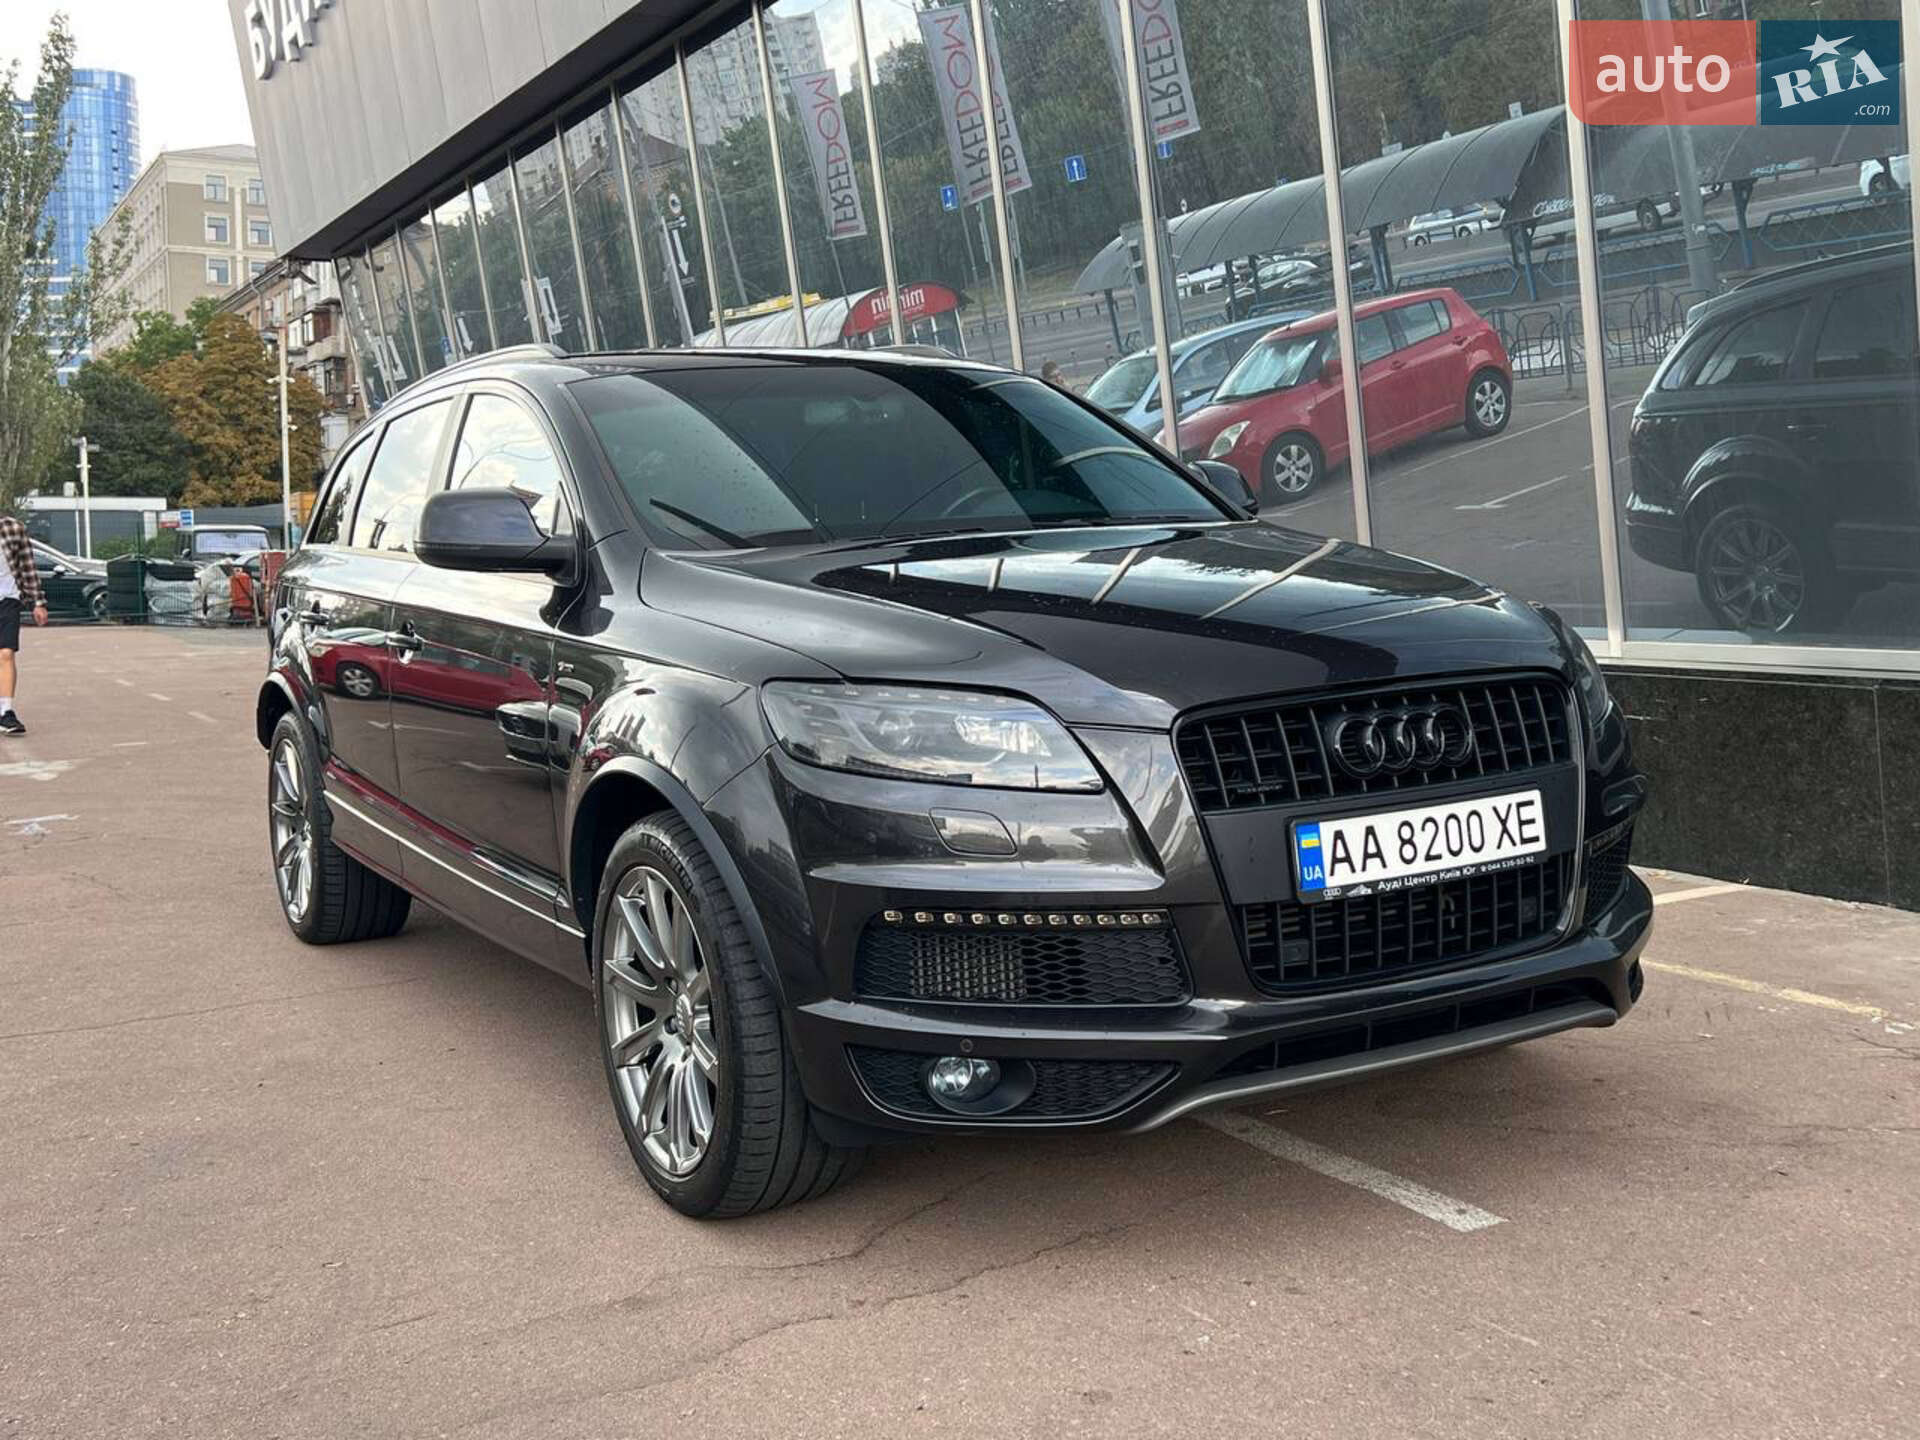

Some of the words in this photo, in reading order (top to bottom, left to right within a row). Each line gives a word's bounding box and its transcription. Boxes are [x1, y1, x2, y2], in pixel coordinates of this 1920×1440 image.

[243, 0, 322, 80] БУД
[1329, 825, 1388, 877] AA
[1397, 809, 1486, 865] 8200
[1492, 799, 1541, 850] XE
[1303, 865, 1324, 881] UA
[1404, 875, 1438, 888] Центр
